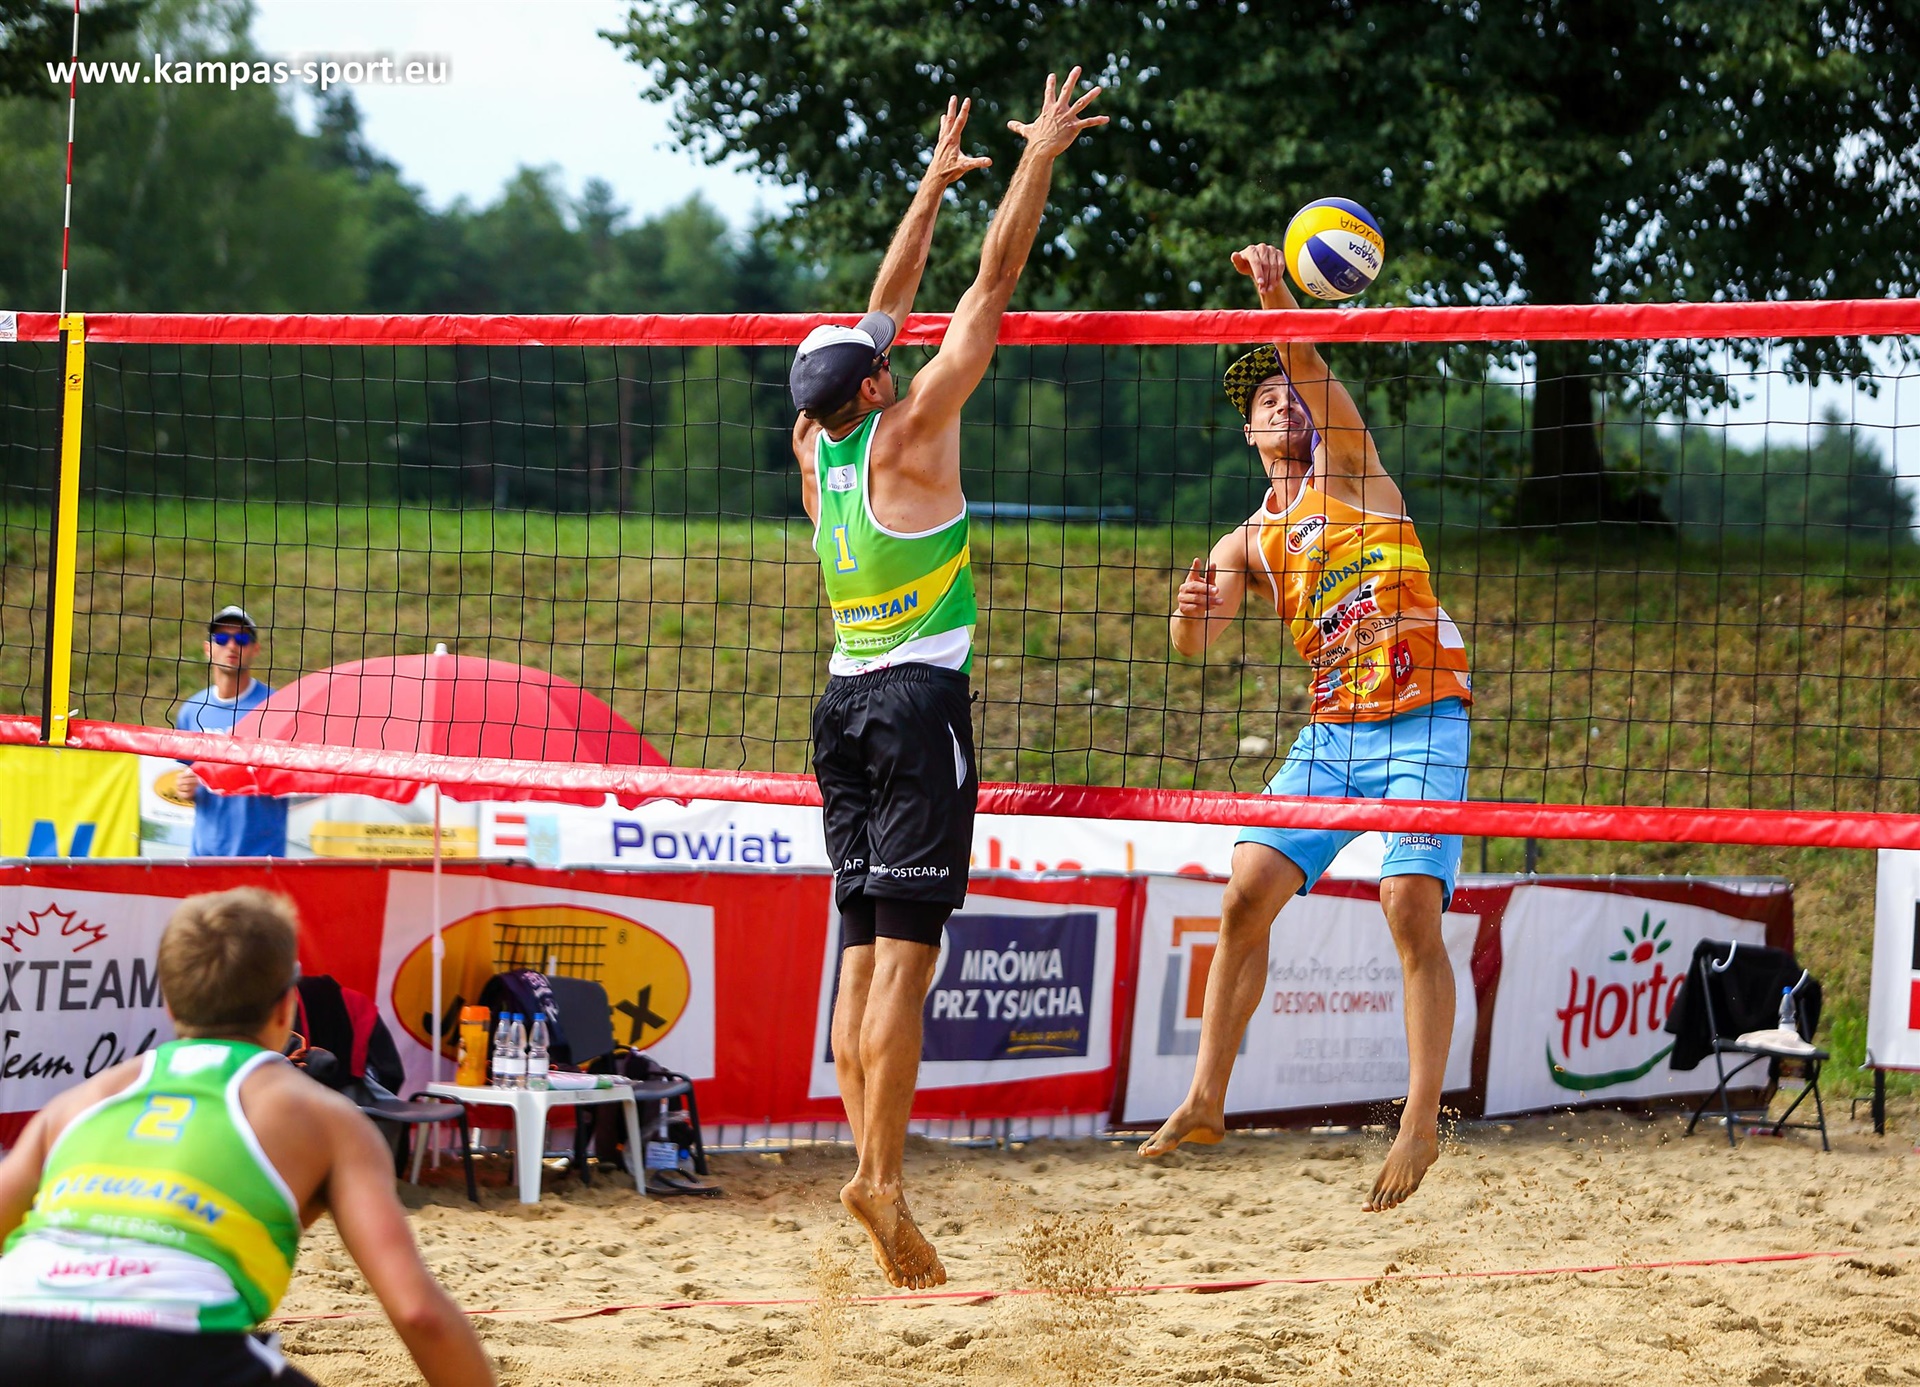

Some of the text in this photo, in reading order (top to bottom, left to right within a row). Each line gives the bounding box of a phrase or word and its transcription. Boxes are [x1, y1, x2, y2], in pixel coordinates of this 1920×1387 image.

[832, 524, 858, 574] 1
[1290, 518, 1322, 548] TOMPEX
[612, 820, 791, 865] Powiat
[1400, 836, 1442, 848] PROSKOS
[931, 986, 1084, 1020] PRZYSUCHA
[1273, 991, 1395, 1014] DESIGN COMPANY
[1556, 961, 1686, 1058] Horte
[130, 1092, 197, 1140] 2
